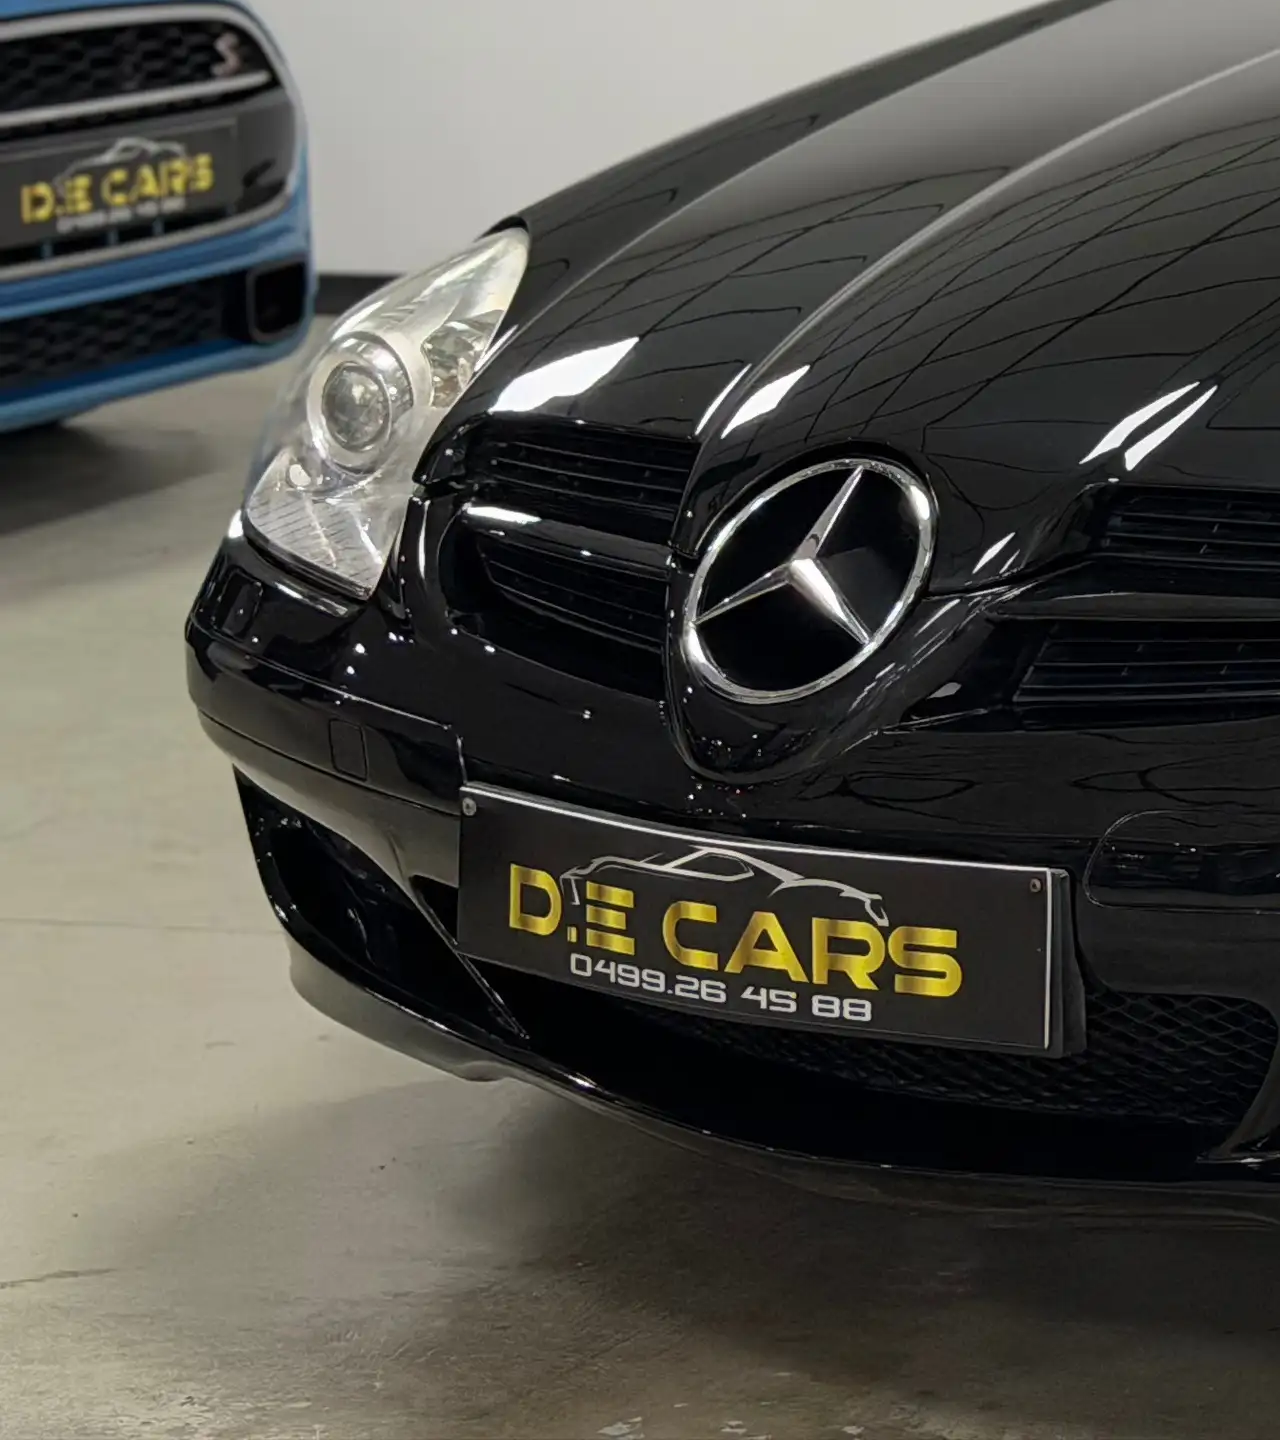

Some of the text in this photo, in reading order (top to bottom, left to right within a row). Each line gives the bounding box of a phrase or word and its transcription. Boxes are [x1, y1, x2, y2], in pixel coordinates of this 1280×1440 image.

[100, 153, 214, 208] CARS
[508, 863, 964, 999] D.E CARS
[569, 953, 873, 1022] 0499.26 45 88
